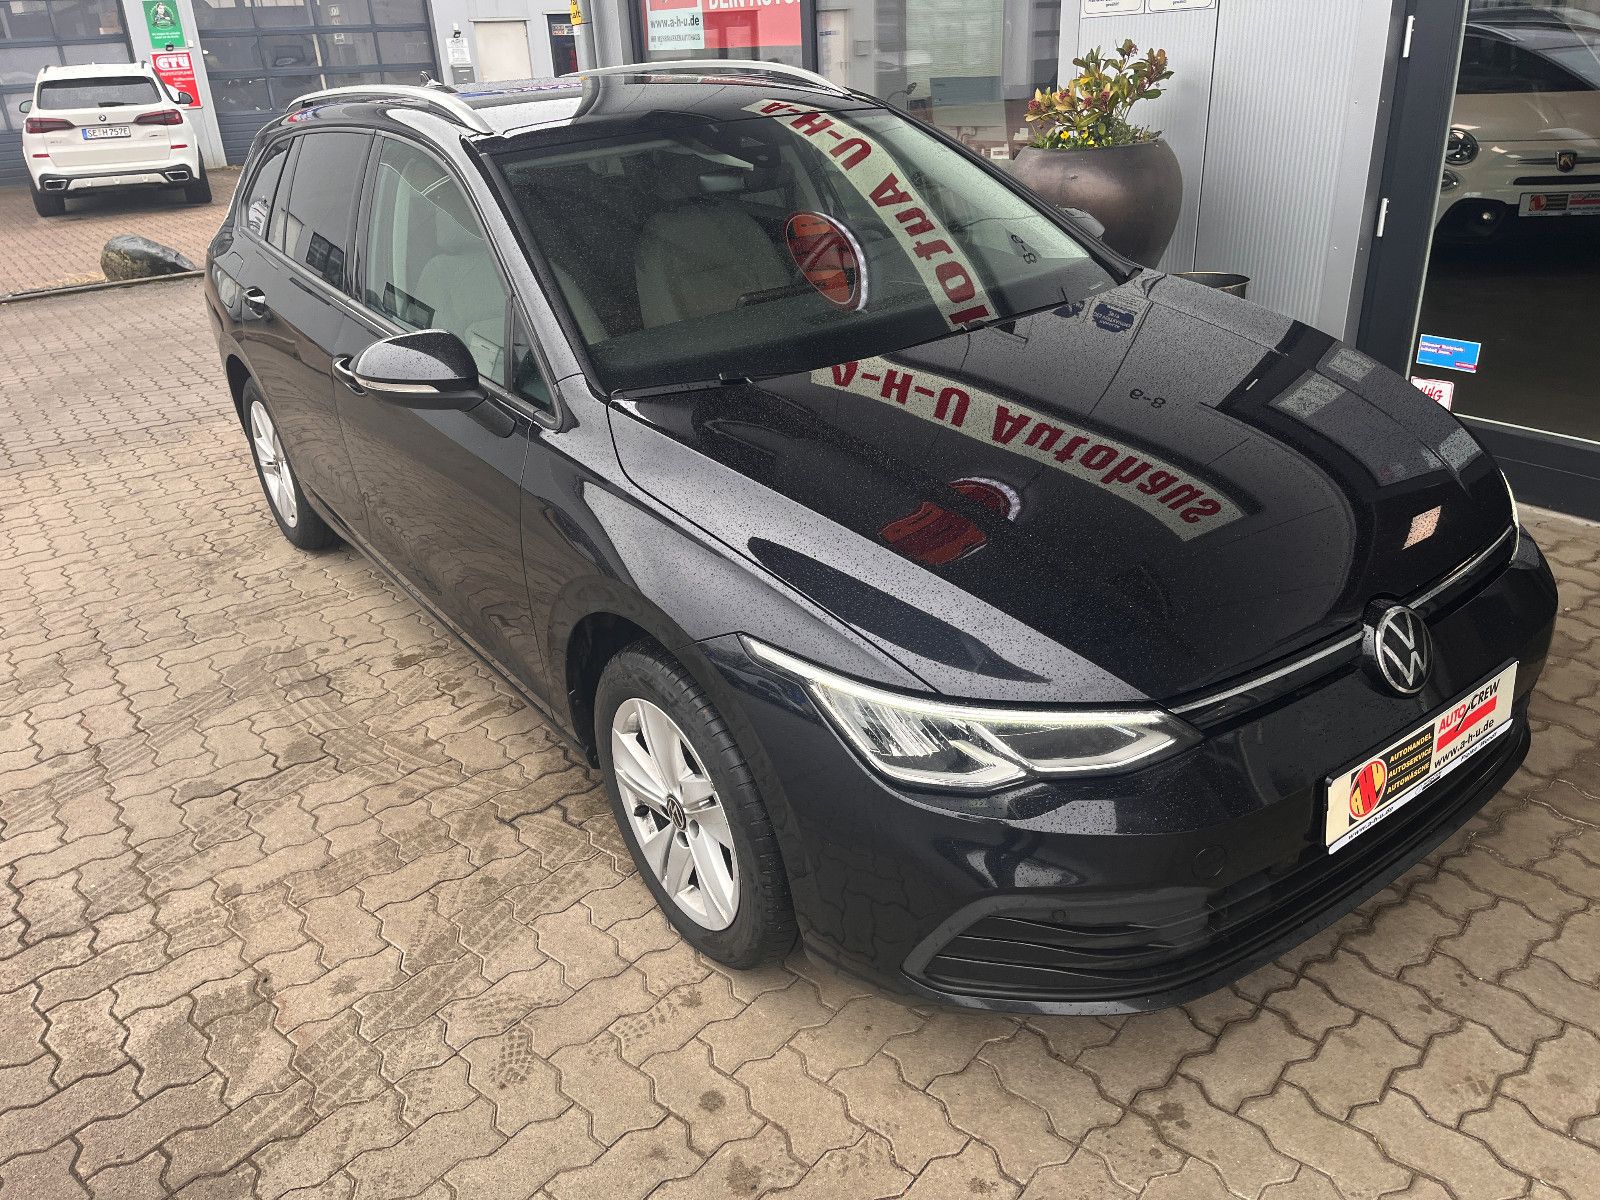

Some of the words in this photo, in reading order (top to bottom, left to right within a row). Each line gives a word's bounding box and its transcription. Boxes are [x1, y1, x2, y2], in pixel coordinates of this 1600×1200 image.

[650, 15, 700, 28] www.a-h-u.de
[1389, 733, 1432, 763] AUTOHANDEL
[1434, 719, 1495, 769] www.a-h-u.de
[1388, 746, 1433, 779] AUTOSERVICE
